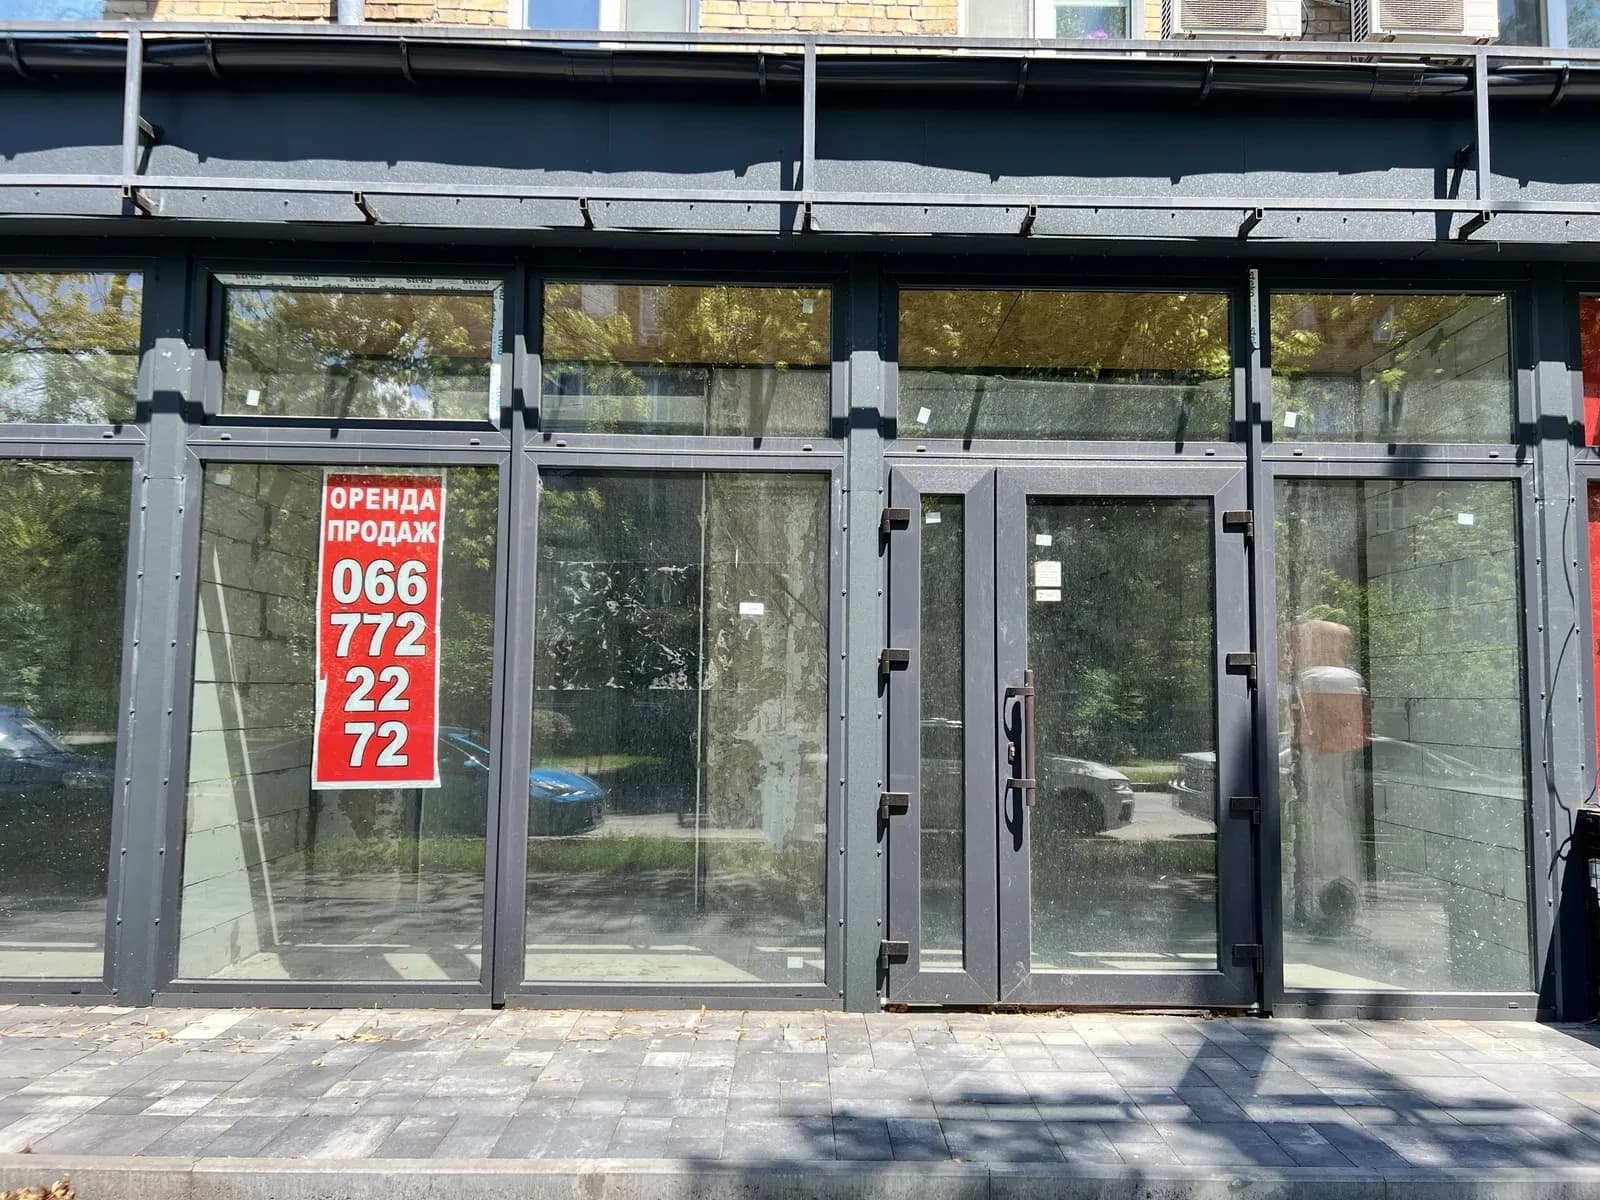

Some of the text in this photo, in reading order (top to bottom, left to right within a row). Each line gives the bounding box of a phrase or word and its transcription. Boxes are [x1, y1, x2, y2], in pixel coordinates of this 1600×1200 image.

[330, 486, 435, 514] ОРЕНДА
[327, 519, 436, 546] ПРОДАЖ
[332, 558, 428, 605] 066
[330, 611, 427, 657] 772
[344, 665, 410, 712] 22
[344, 720, 409, 767] 72
